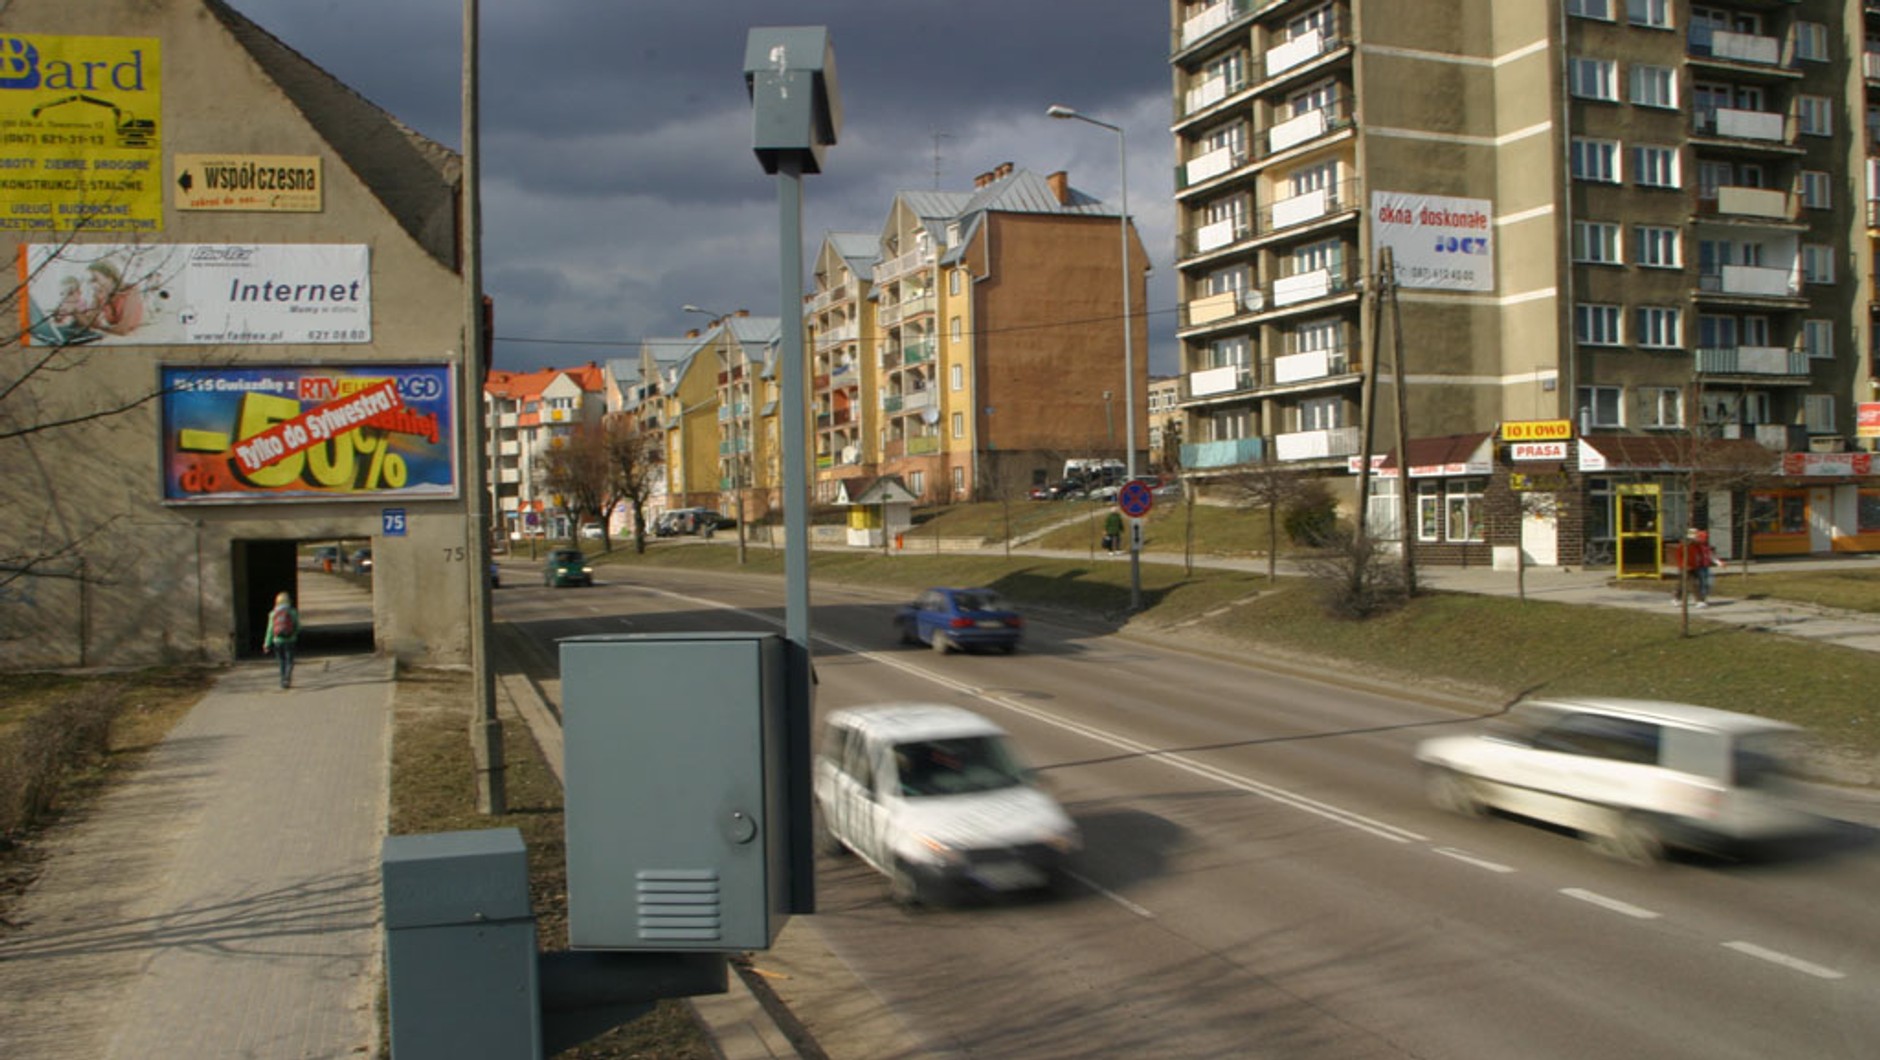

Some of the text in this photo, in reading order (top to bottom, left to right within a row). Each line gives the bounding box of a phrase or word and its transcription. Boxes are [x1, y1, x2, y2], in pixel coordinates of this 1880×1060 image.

[205, 162, 316, 191] współczesna
[1379, 203, 1412, 225] okna
[230, 278, 360, 302] Internet
[300, 377, 340, 399] RTV
[397, 376, 441, 398] AGD
[1535, 424, 1567, 436] OWO
[236, 435, 283, 470] Tylko
[283, 420, 308, 449] do
[1516, 446, 1561, 457] PRASA
[180, 464, 221, 493] do
[385, 515, 404, 530] 75
[443, 546, 465, 563] 75
